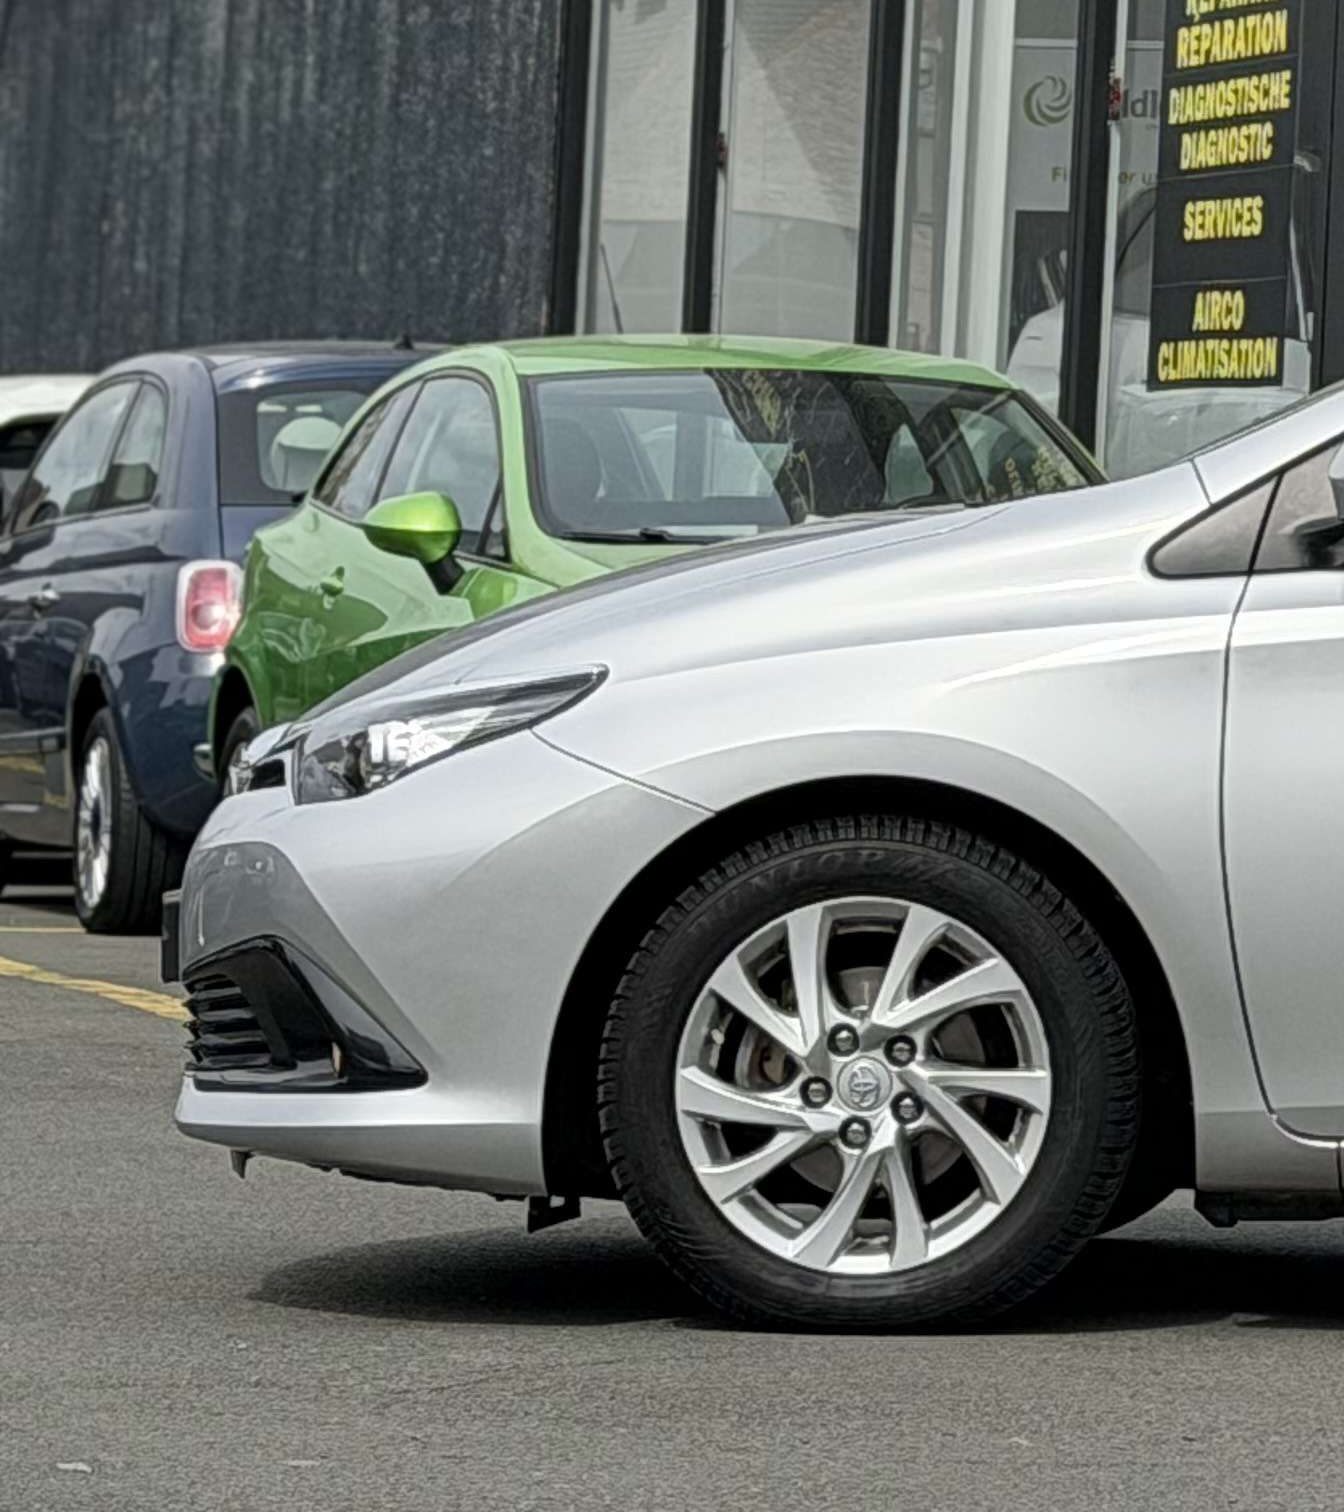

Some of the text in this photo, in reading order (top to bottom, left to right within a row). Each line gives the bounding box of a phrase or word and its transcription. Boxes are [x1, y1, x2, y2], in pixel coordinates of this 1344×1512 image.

[1168, 70, 1291, 124] DIAGNOSTISCHE
[1180, 121, 1274, 170] DIAGNOSTIC
[1184, 195, 1264, 241] SERVICES
[1192, 289, 1245, 332] AIRCO
[1158, 336, 1278, 382] CLIMATISATION
